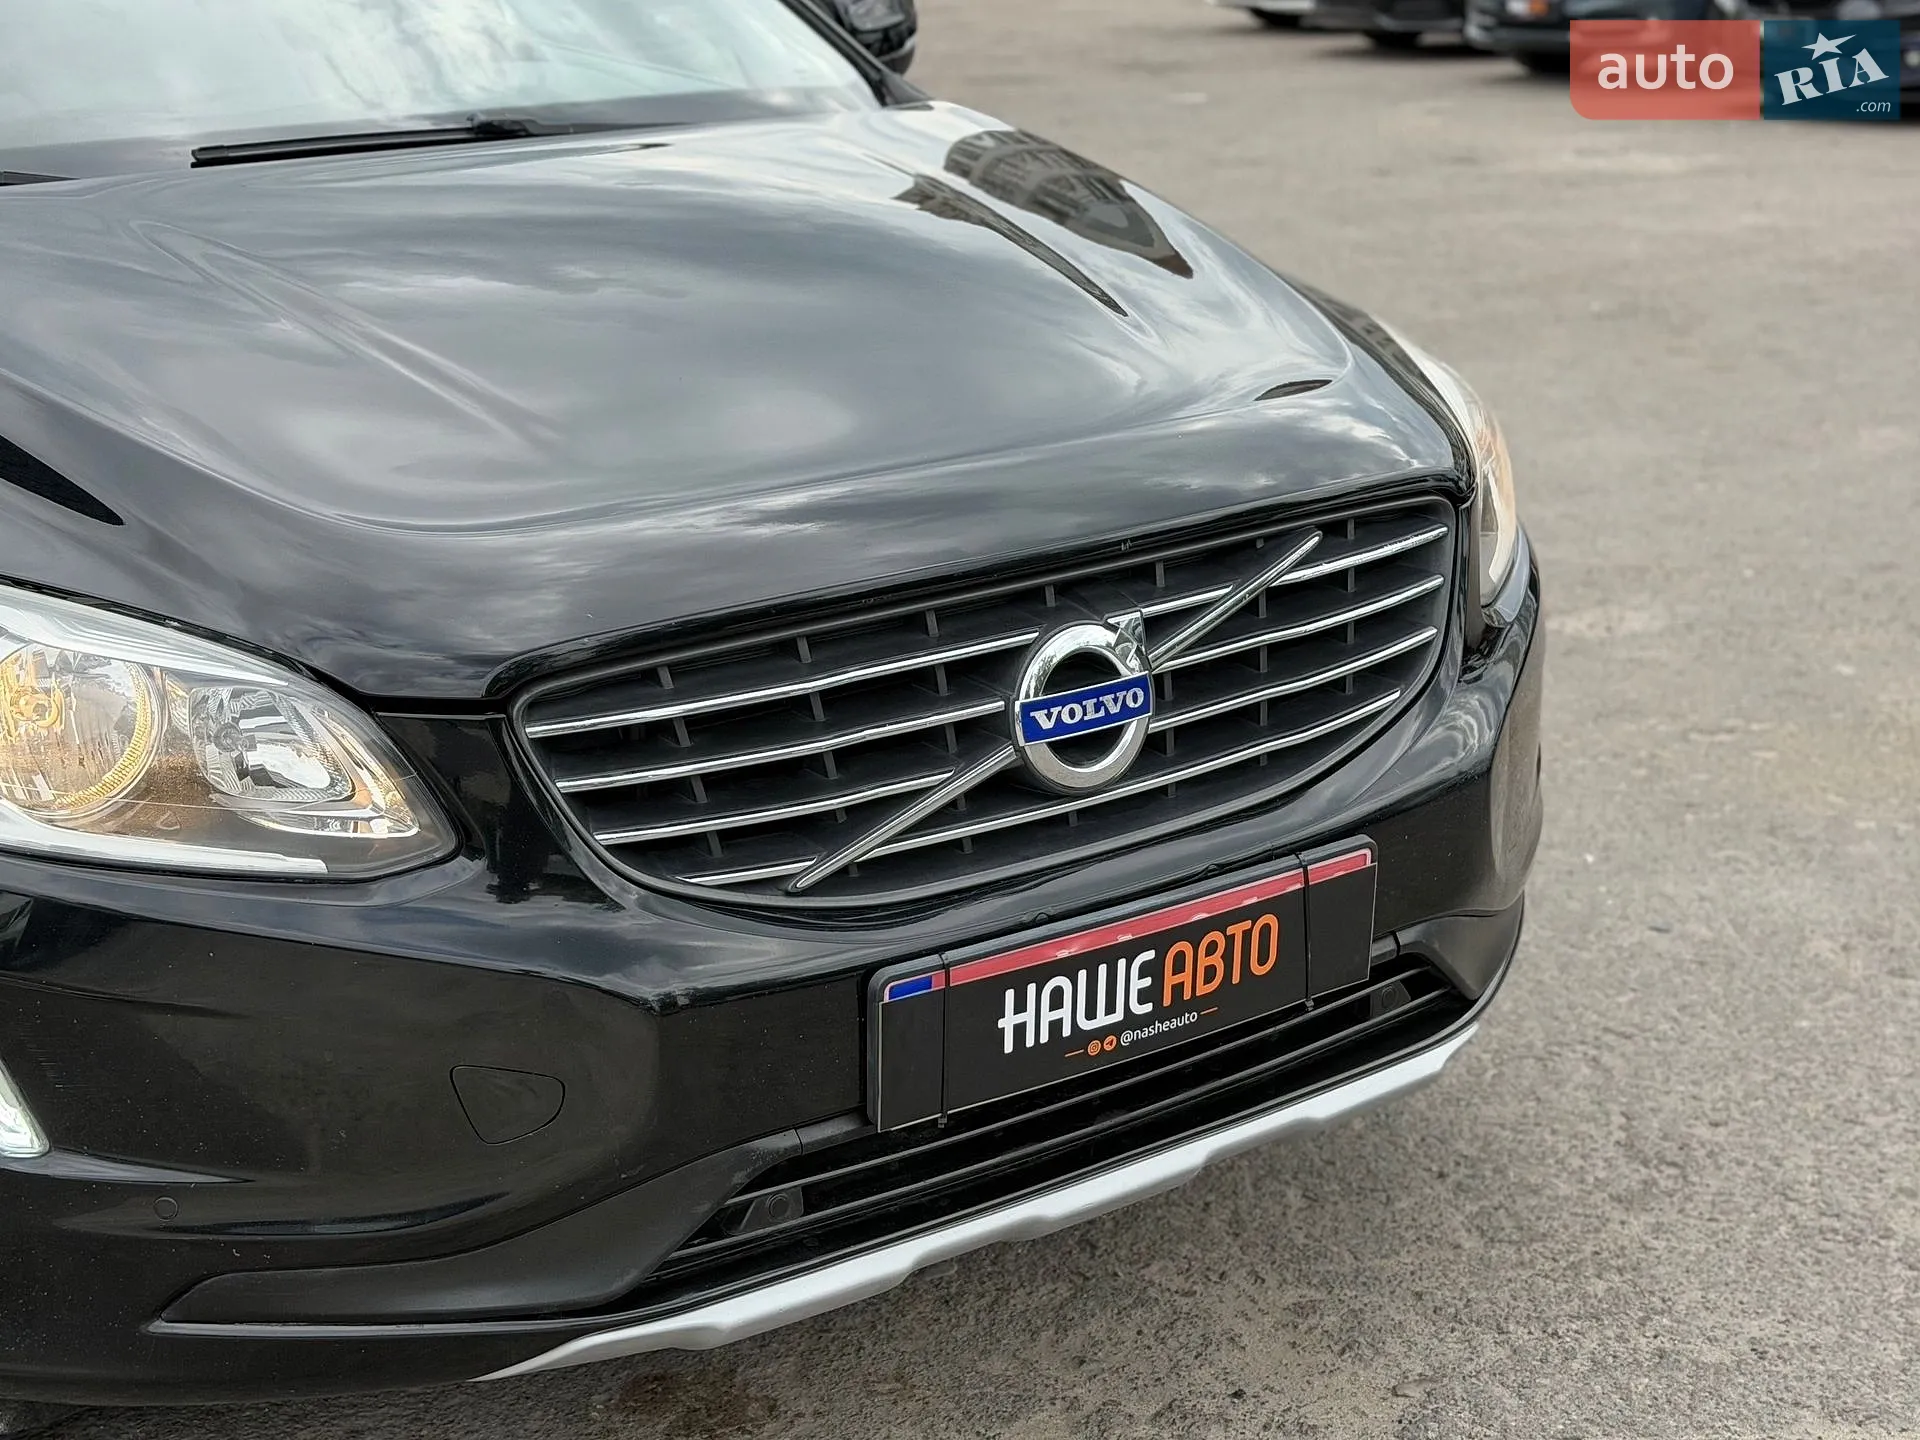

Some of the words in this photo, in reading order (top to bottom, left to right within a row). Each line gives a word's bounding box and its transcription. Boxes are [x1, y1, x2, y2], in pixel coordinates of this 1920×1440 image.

[1029, 687, 1145, 730] VOLVO
[997, 949, 1155, 1055] НАШЕ
[1162, 913, 1279, 1007] АВТО
[1120, 1009, 1199, 1047] @nasheauto
